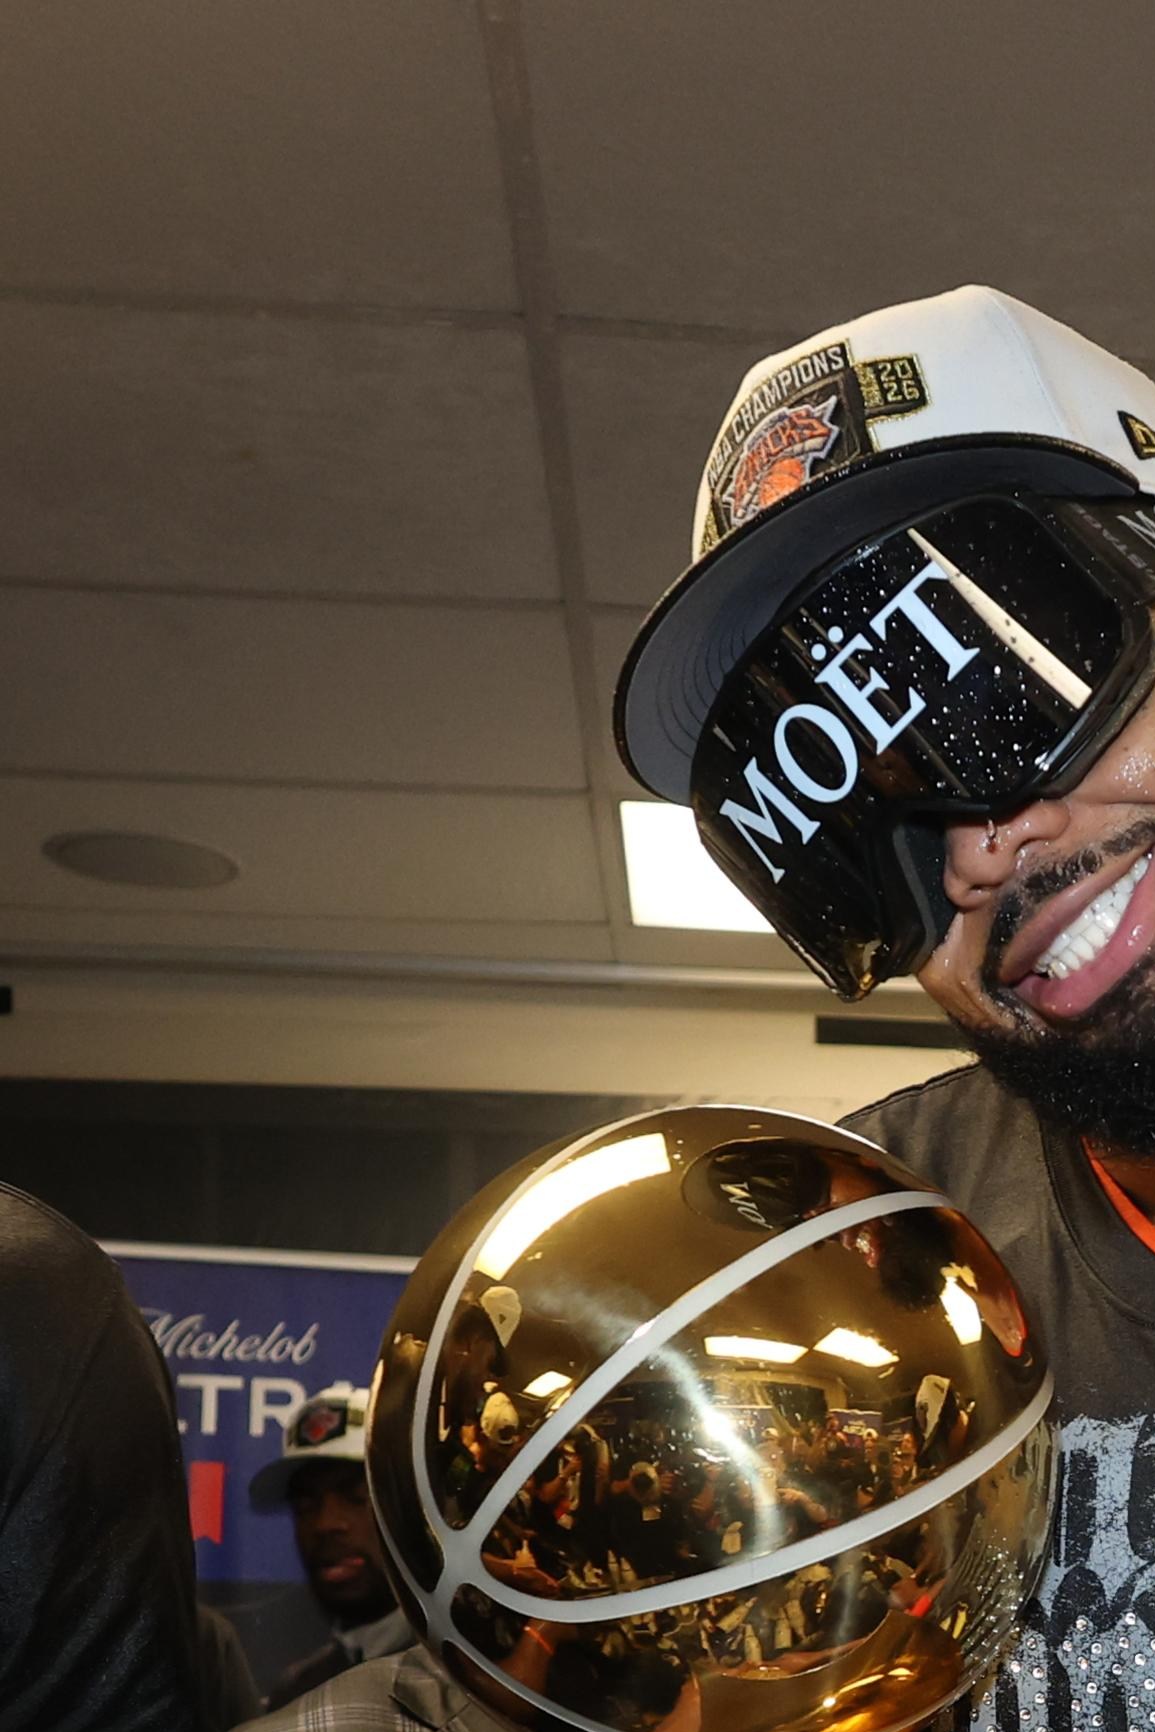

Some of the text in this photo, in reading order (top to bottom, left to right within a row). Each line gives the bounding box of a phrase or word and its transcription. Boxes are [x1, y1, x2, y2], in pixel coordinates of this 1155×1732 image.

[732, 346, 845, 443] CHAMPIONS
[878, 361, 913, 382] 20
[883, 381, 920, 401] 26
[719, 560, 980, 884] MOËT
[138, 1307, 320, 1366] Michelob
